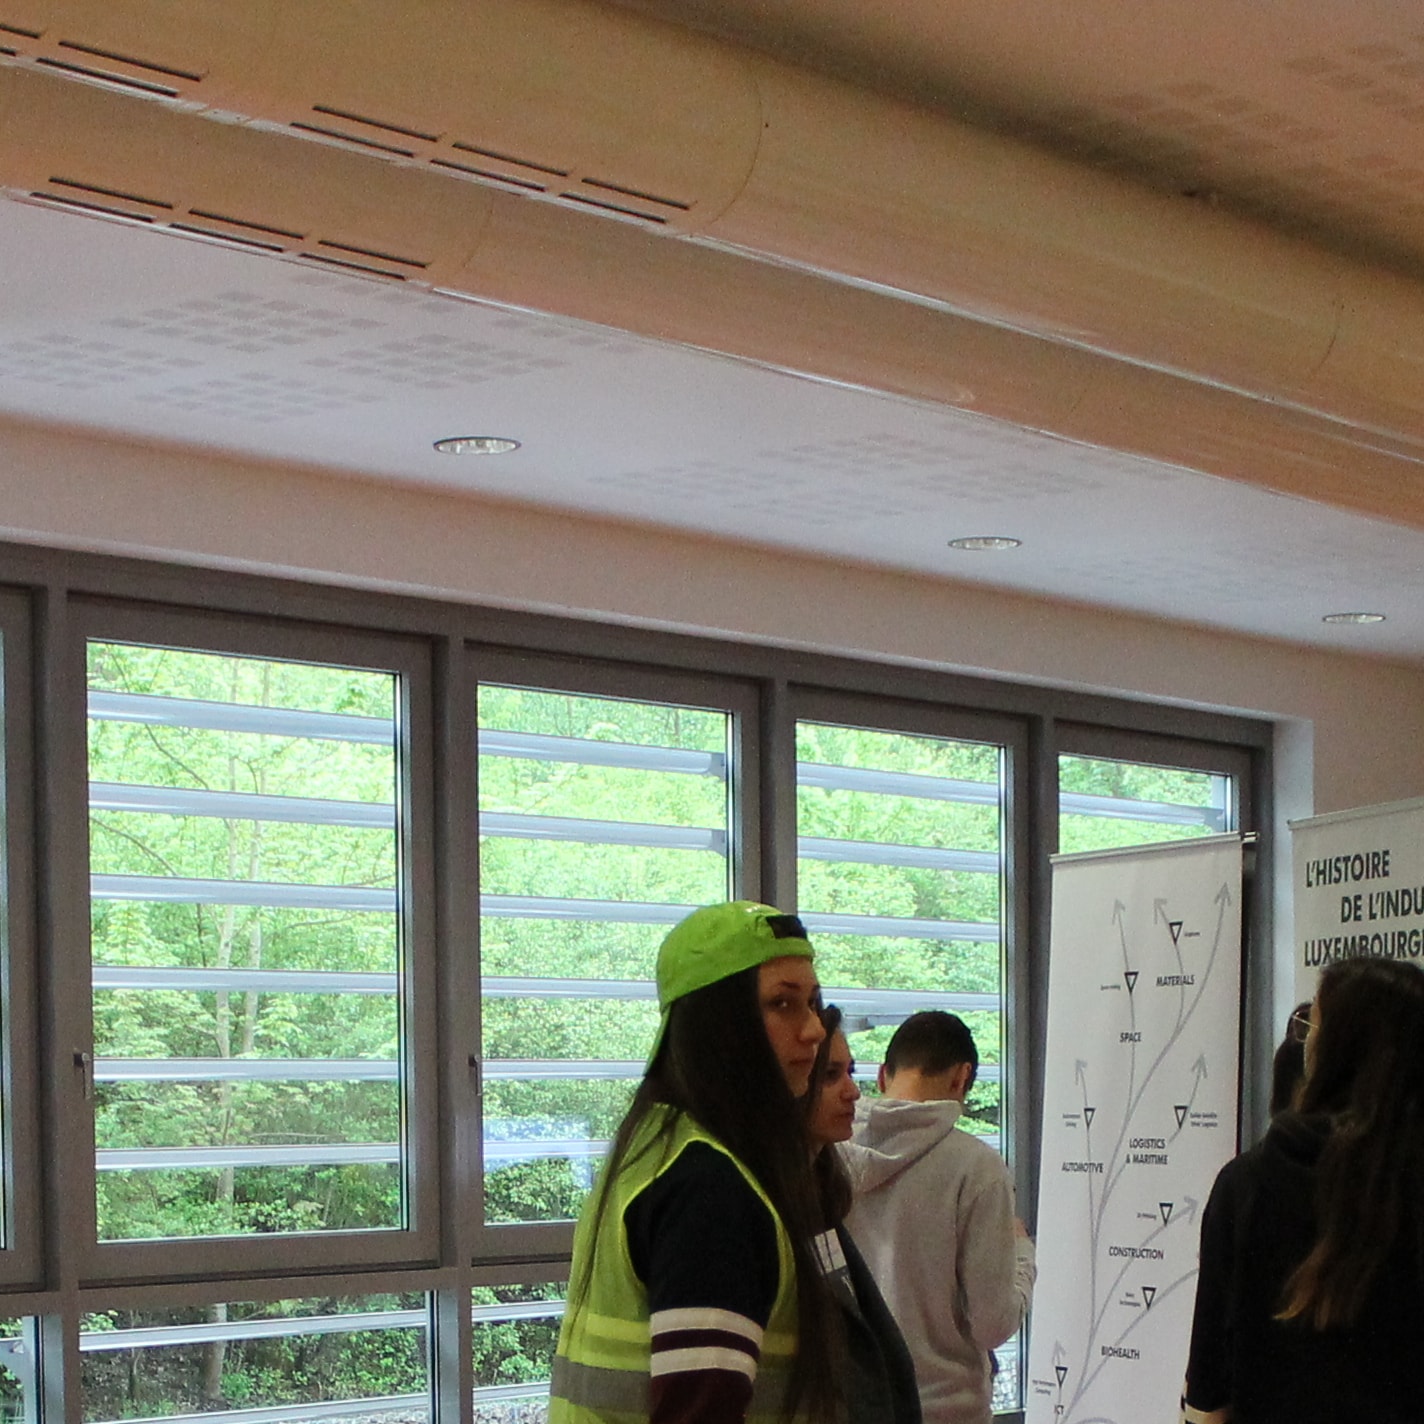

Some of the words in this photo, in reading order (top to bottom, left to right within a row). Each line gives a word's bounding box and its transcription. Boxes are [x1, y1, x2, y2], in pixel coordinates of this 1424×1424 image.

[1306, 850, 1390, 888] L'HISTOIRE
[1341, 894, 1362, 923] DE
[1156, 975, 1195, 987] MATERIALS
[1119, 1032, 1142, 1043] SPACE
[1129, 1138, 1166, 1150] LOGISTICS
[1133, 1154, 1168, 1165] MARITIME
[1061, 1162, 1104, 1174] AUTOMOTIVE
[1108, 1246, 1165, 1260] CONSTRUCTION
[1101, 1345, 1141, 1360] BIOHEALTH
